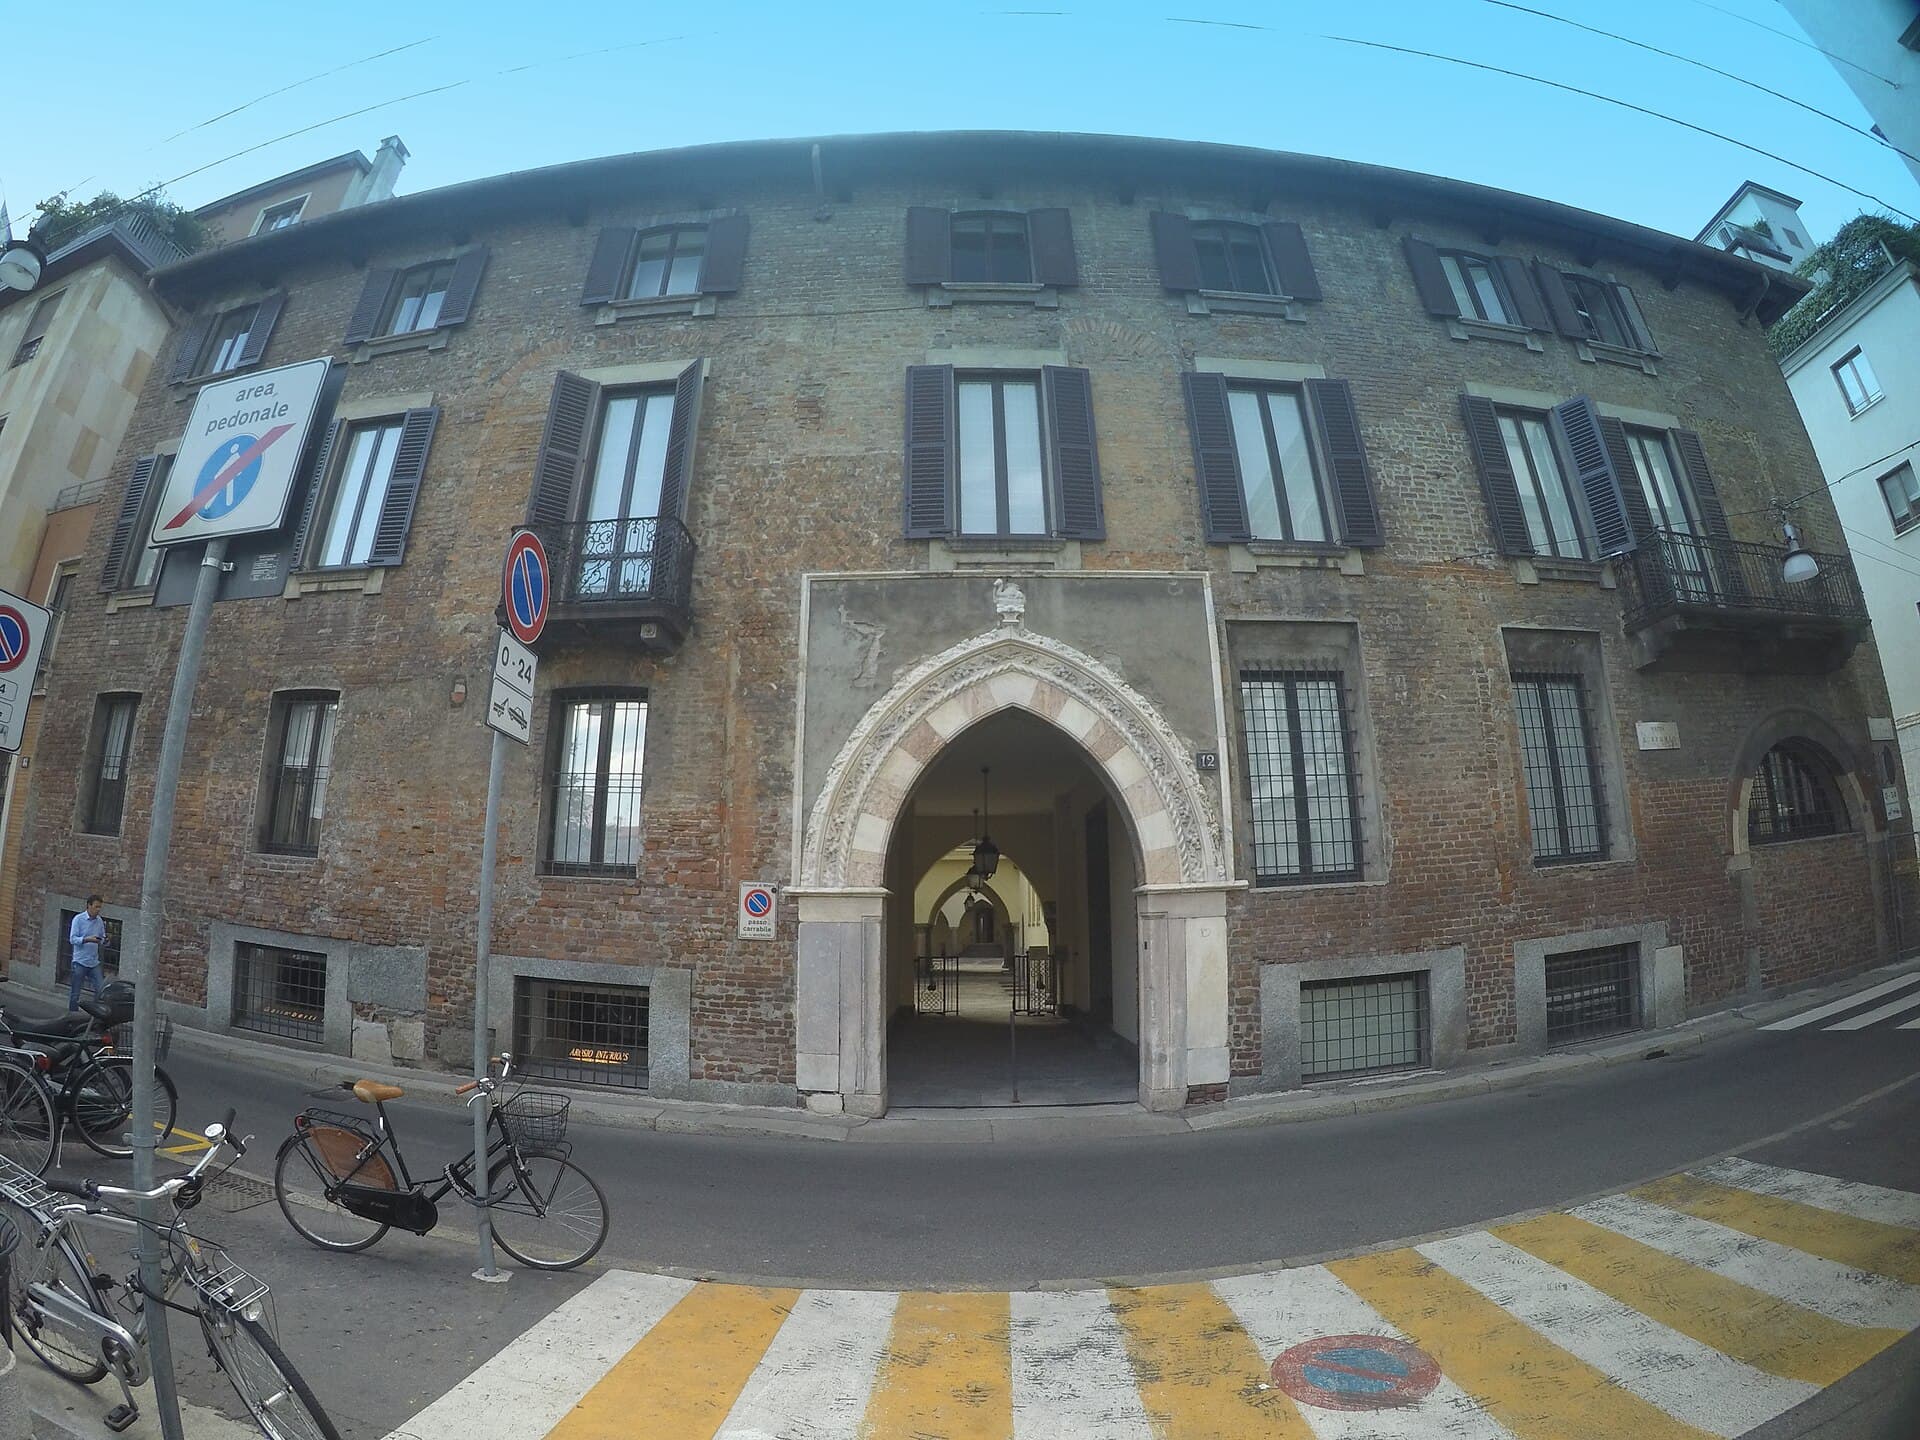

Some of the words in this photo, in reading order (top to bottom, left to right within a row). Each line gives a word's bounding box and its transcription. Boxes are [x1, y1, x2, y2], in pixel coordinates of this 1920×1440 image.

[235, 382, 276, 402] area
[204, 401, 289, 436] pedonale
[1201, 754, 1215, 767] 12
[742, 925, 772, 933] carrabile
